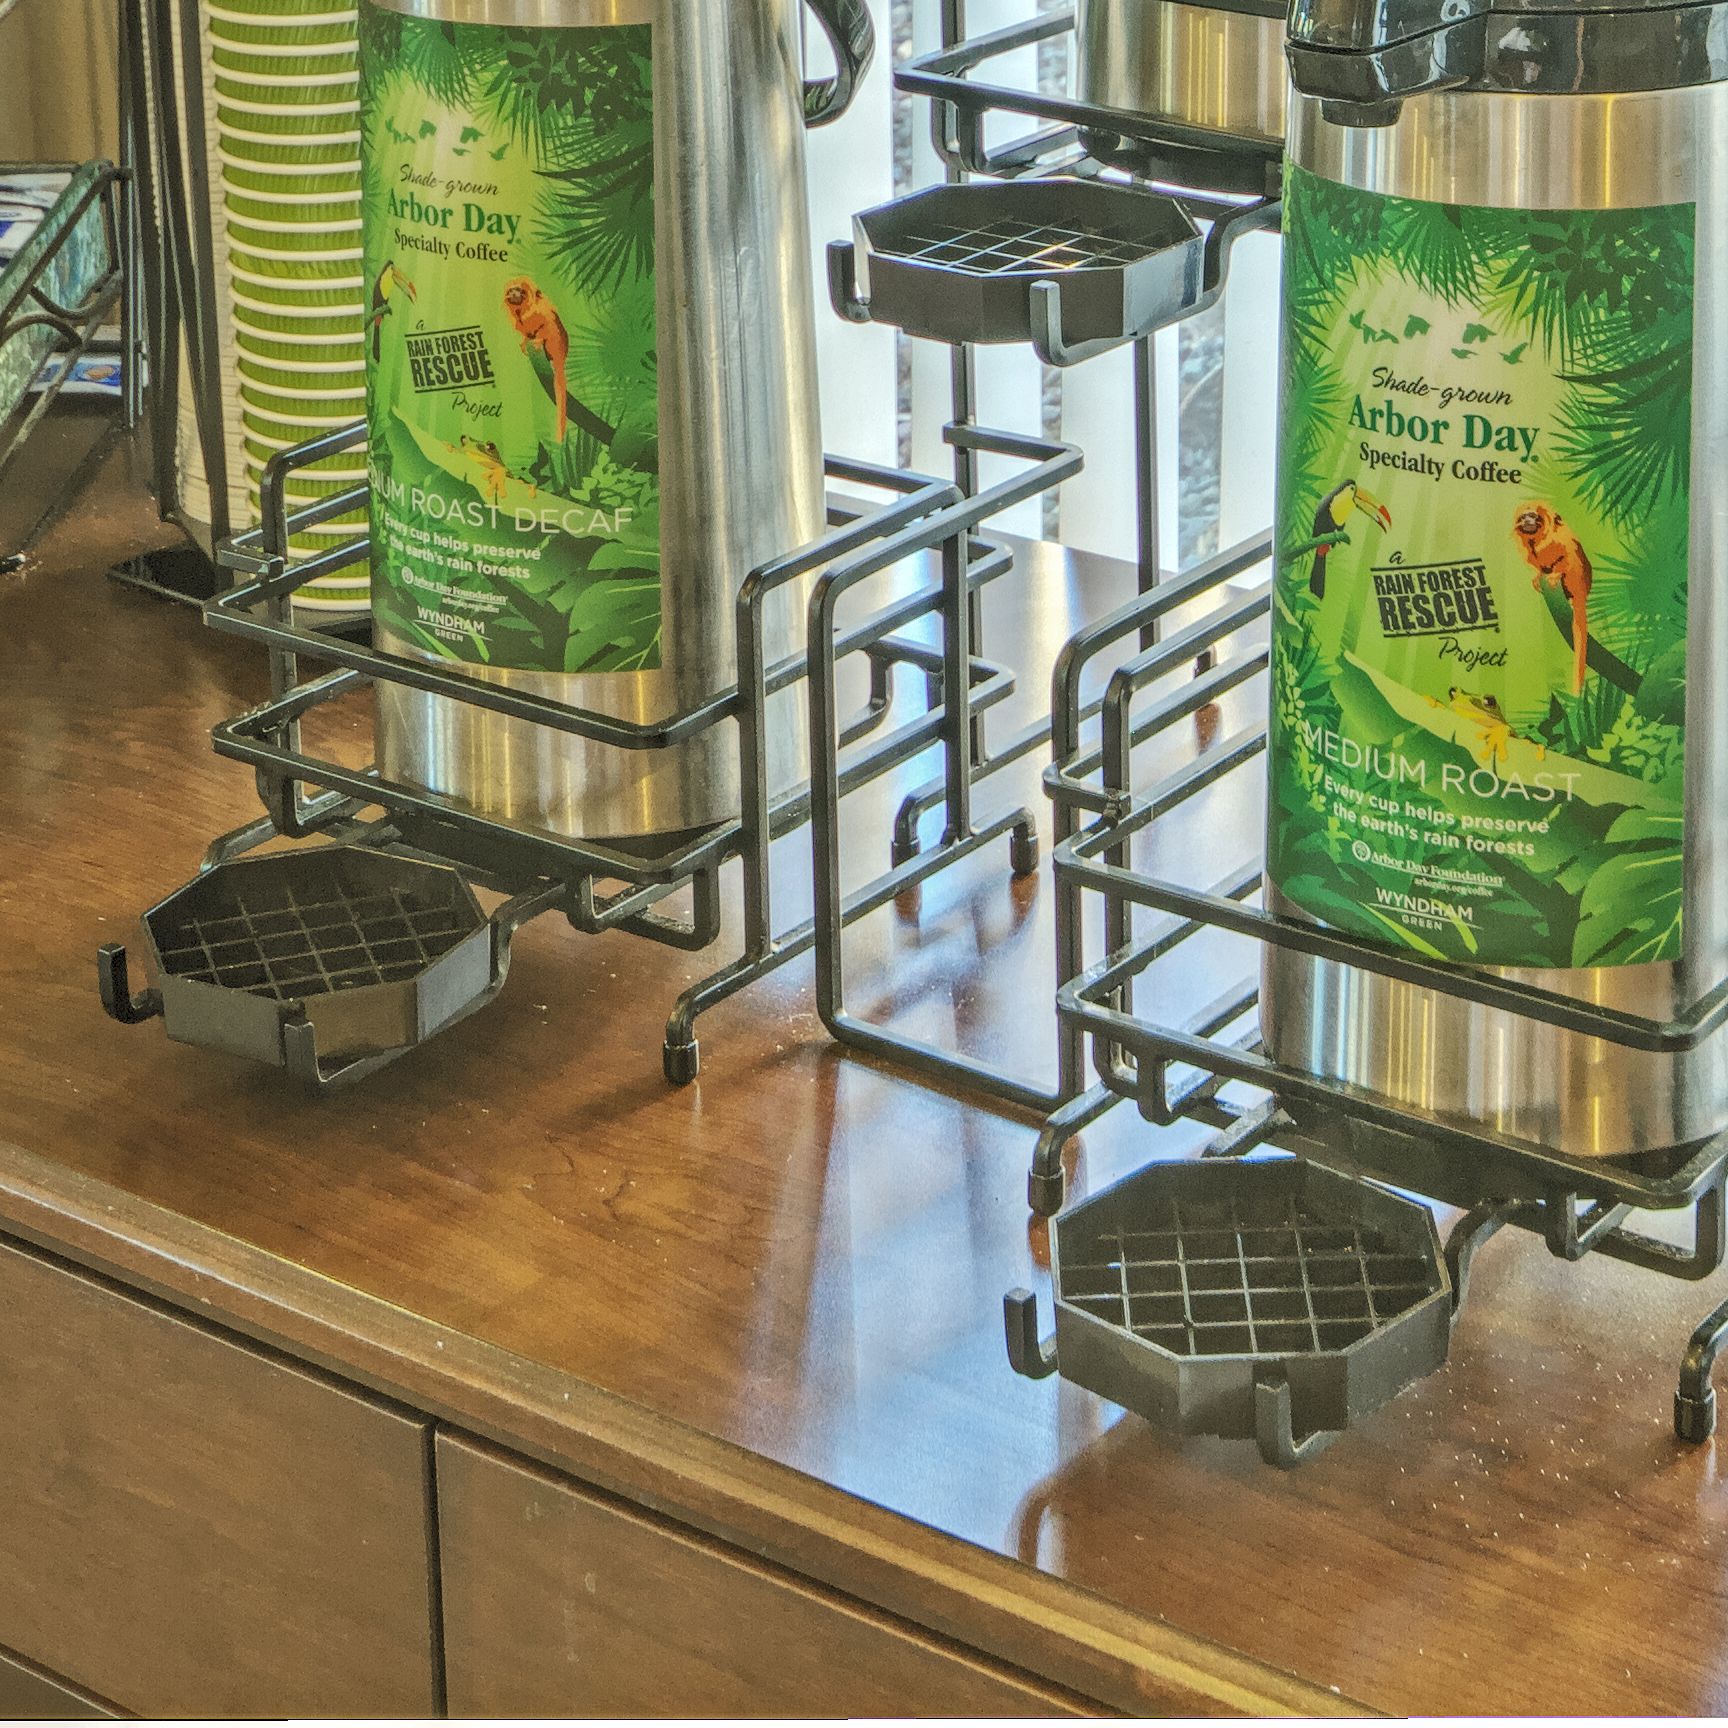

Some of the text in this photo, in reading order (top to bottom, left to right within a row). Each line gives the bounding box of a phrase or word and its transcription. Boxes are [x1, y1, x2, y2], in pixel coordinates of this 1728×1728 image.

[400, 163, 499, 198] Shade-grown
[387, 188, 521, 244] Arbor Day
[394, 228, 508, 262] Specialty Coffee
[407, 331, 486, 356] RAIN FOREST
[410, 348, 495, 388] RESCUE
[1371, 366, 1513, 409] Shade-grown
[451, 391, 503, 422] Project
[1348, 394, 1540, 463] Arbor Day
[1359, 442, 1522, 485] Specialty Coffee
[412, 487, 502, 529] ROAST
[515, 507, 633, 534] DECAF
[384, 511, 541, 560] Every cup helps preserve
[389, 533, 531, 579] the earth's rain forests
[1388, 550, 1406, 566] a
[1373, 564, 1487, 596] RAIN FOREST
[417, 605, 485, 634] WYNDHAM
[1378, 585, 1498, 632] RESCUE
[1438, 636, 1508, 671] Project
[1305, 719, 1582, 803] MEDIUM ROAST
[1324, 774, 1550, 836] Every cup helps preserve
[1333, 800, 1535, 857] the earth's rain forests
[1371, 851, 1404, 868] Arbor
[1406, 859, 1430, 874] Day
[1375, 887, 1473, 922] WYNDHAM
[1401, 914, 1443, 931] GREEN
